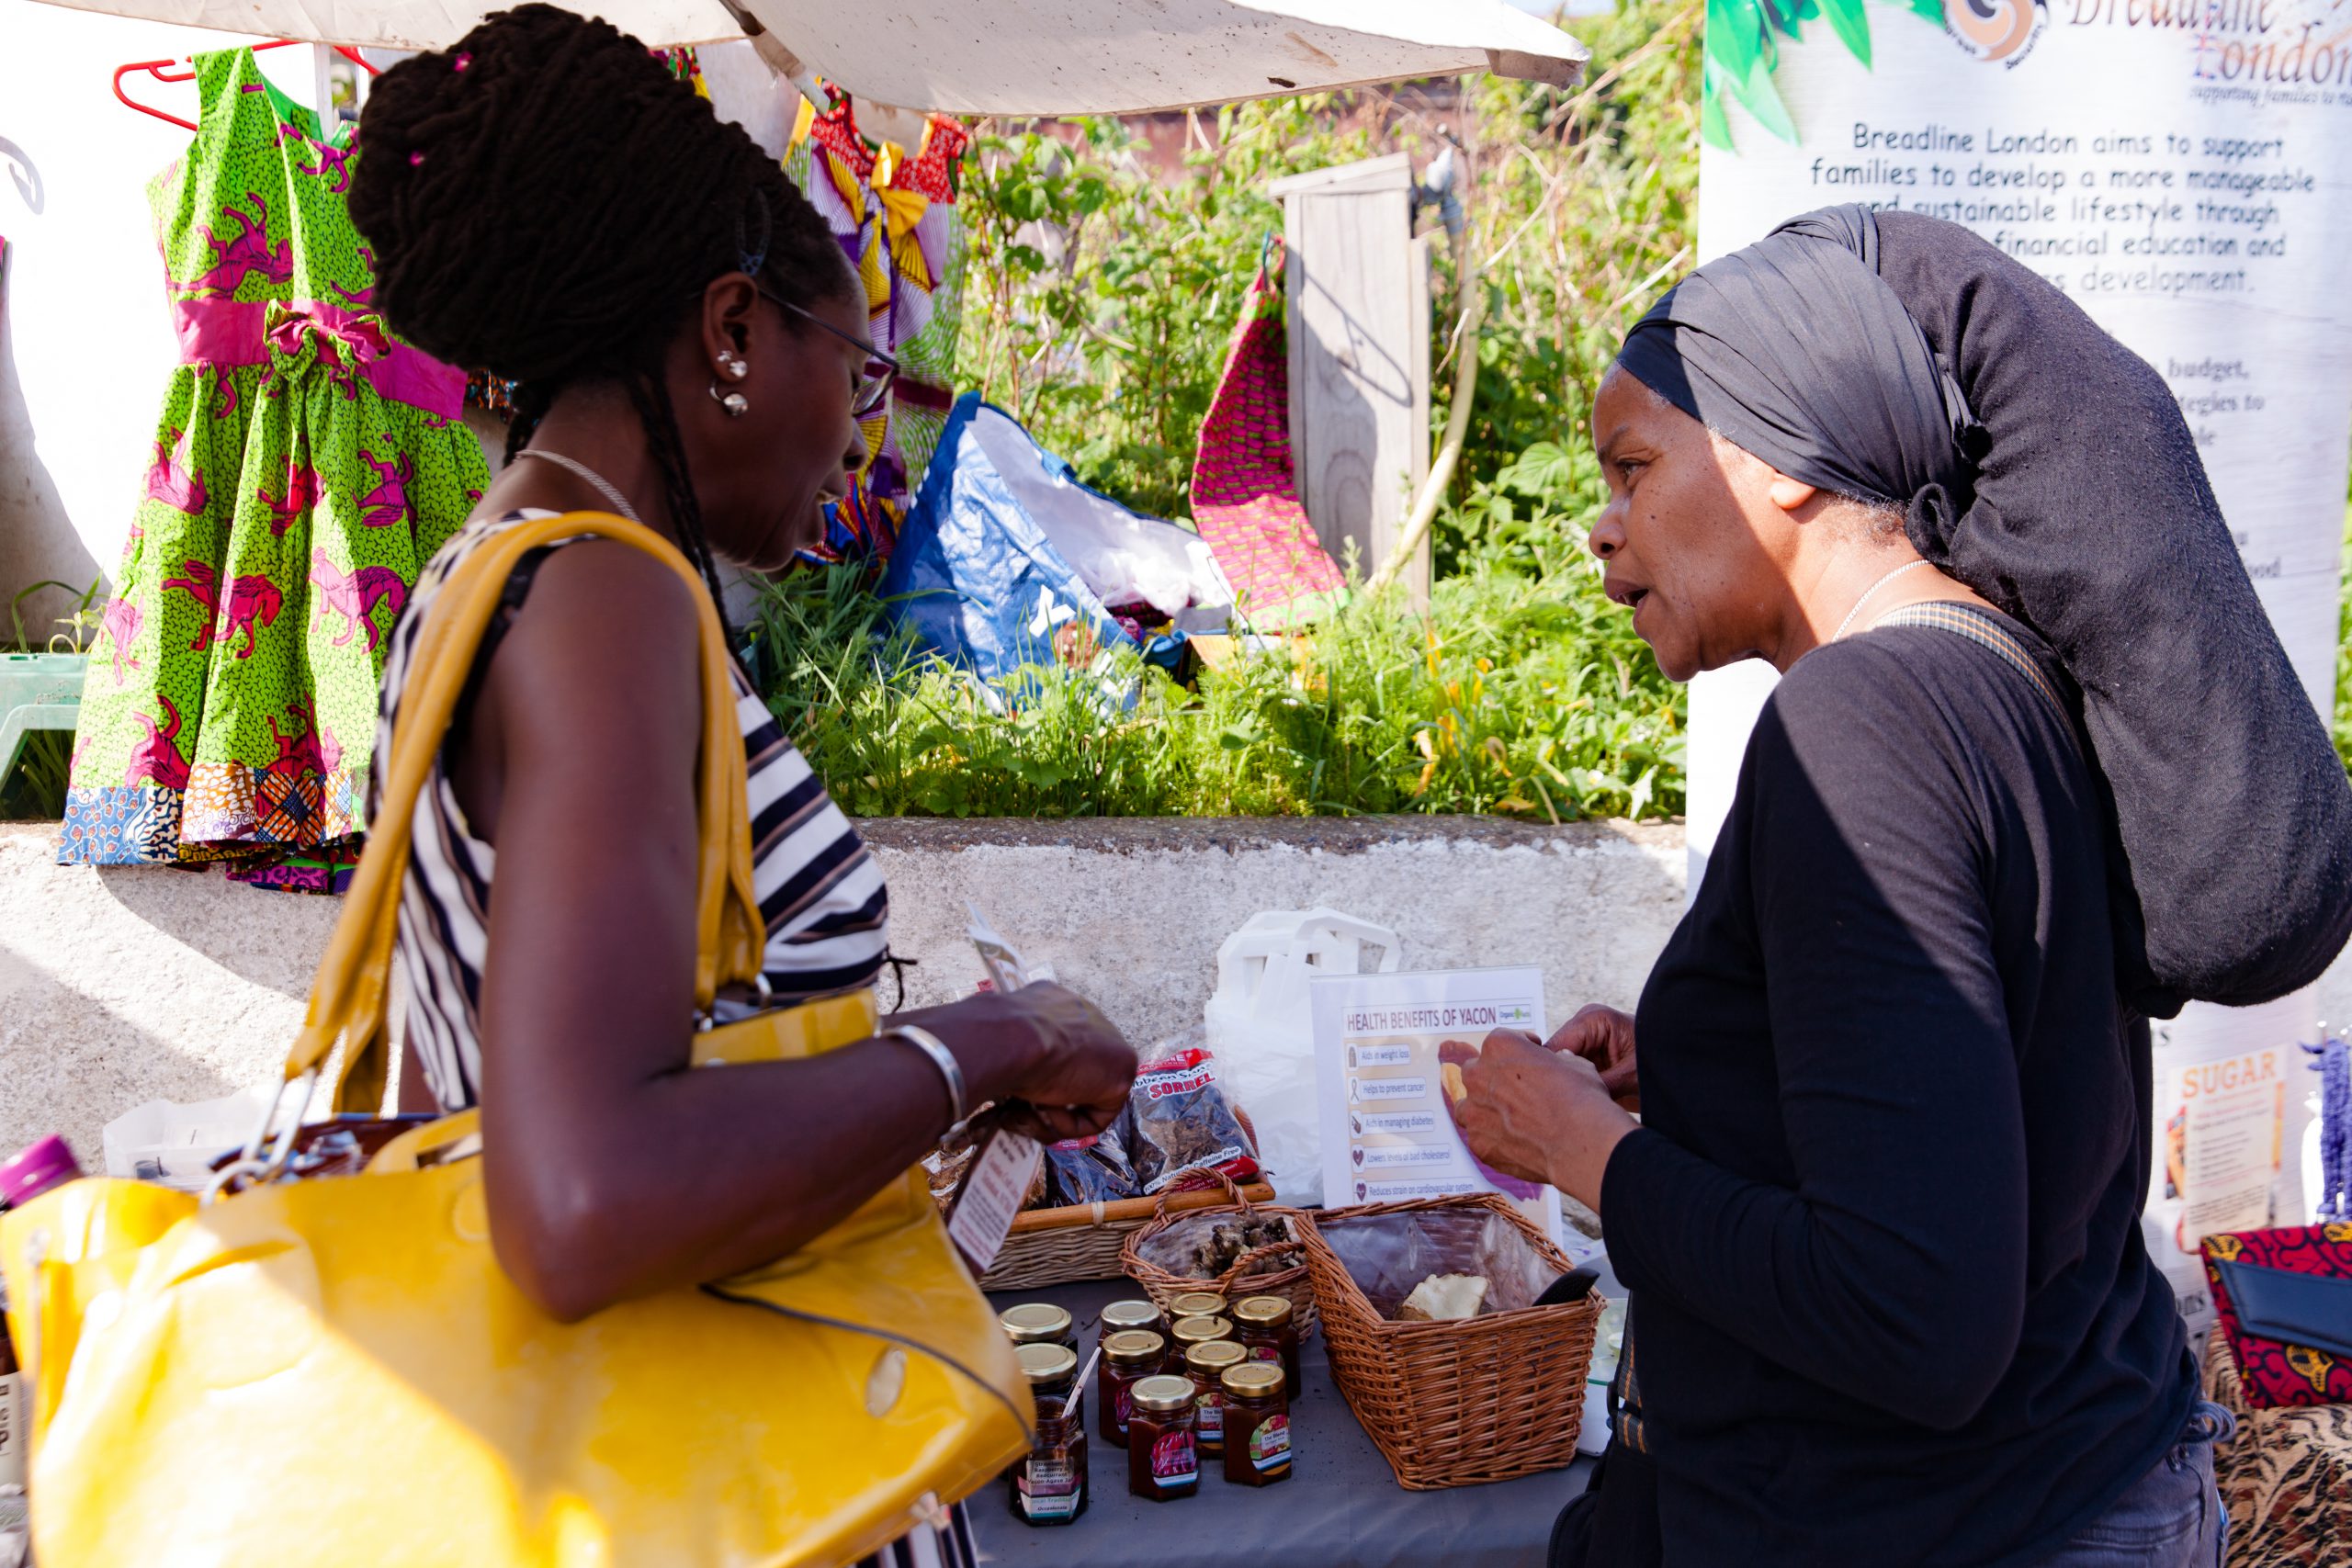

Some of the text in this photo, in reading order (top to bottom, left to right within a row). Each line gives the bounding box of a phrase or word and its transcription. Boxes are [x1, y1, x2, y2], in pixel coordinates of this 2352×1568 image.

[1854, 122, 2283, 163] Breadline London aims to support
[1811, 157, 2315, 197] families to develop a more manageable
[1914, 196, 2056, 223] sustainable
[2071, 196, 2183, 228] lifestyle
[2196, 197, 2279, 230] through
[1995, 231, 2287, 257] financial education and
[2079, 264, 2256, 299] development.
[1347, 1007, 1497, 1032] HEALTH BENEFITS OF YACON
[1381, 1049, 1398, 1061] weight
[1399, 1048, 1409, 1058] loss
[1149, 1072, 1216, 1099] SORREL
[2182, 1051, 2276, 1100] SUGAR
[1363, 1084, 1377, 1095] Helps
[1386, 1084, 1407, 1094] prevent
[1408, 1084, 1425, 1092] cancer
[1385, 1117, 1410, 1128] managing
[1411, 1115, 1434, 1125] diabetes
[1193, 1153, 1223, 1168] Caffeine
[1223, 1146, 1240, 1157] Free
[1369, 1186, 1392, 1196] Reduces
[1393, 1186, 1407, 1195] strain
[1417, 1184, 1454, 1194] cardiovascular
